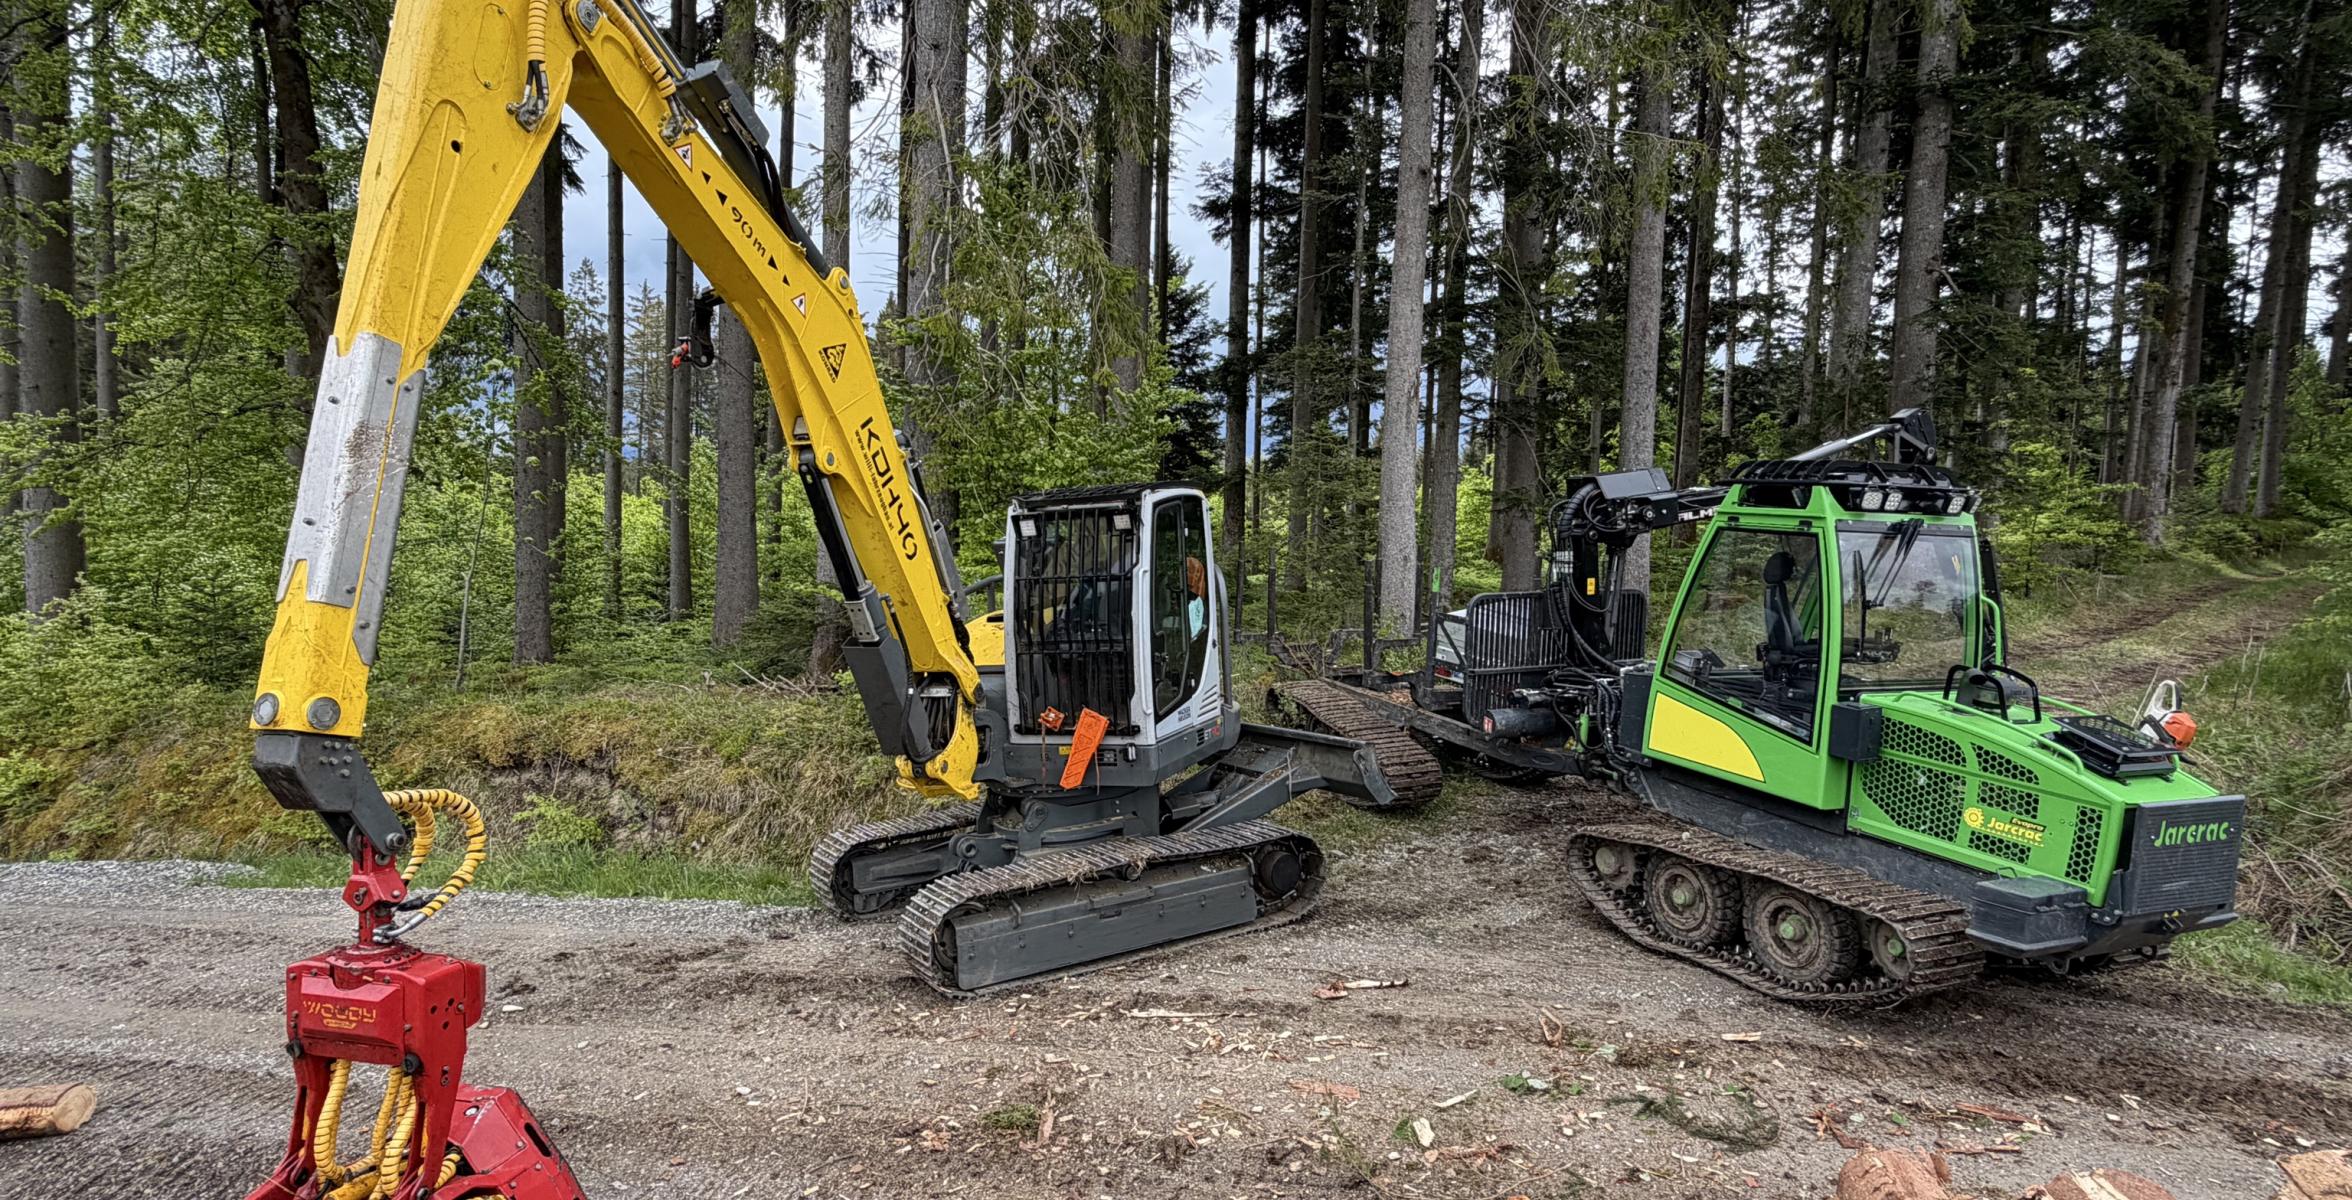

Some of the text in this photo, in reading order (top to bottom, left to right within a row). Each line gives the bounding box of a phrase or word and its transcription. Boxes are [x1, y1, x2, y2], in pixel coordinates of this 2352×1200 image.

[818, 350, 836, 384] KONRAD
[1678, 508, 1716, 521] ALM
[1987, 817, 2043, 842] Jarcrac
[2154, 819, 2230, 847] Jarcrac
[303, 1001, 376, 1022] WOODY
